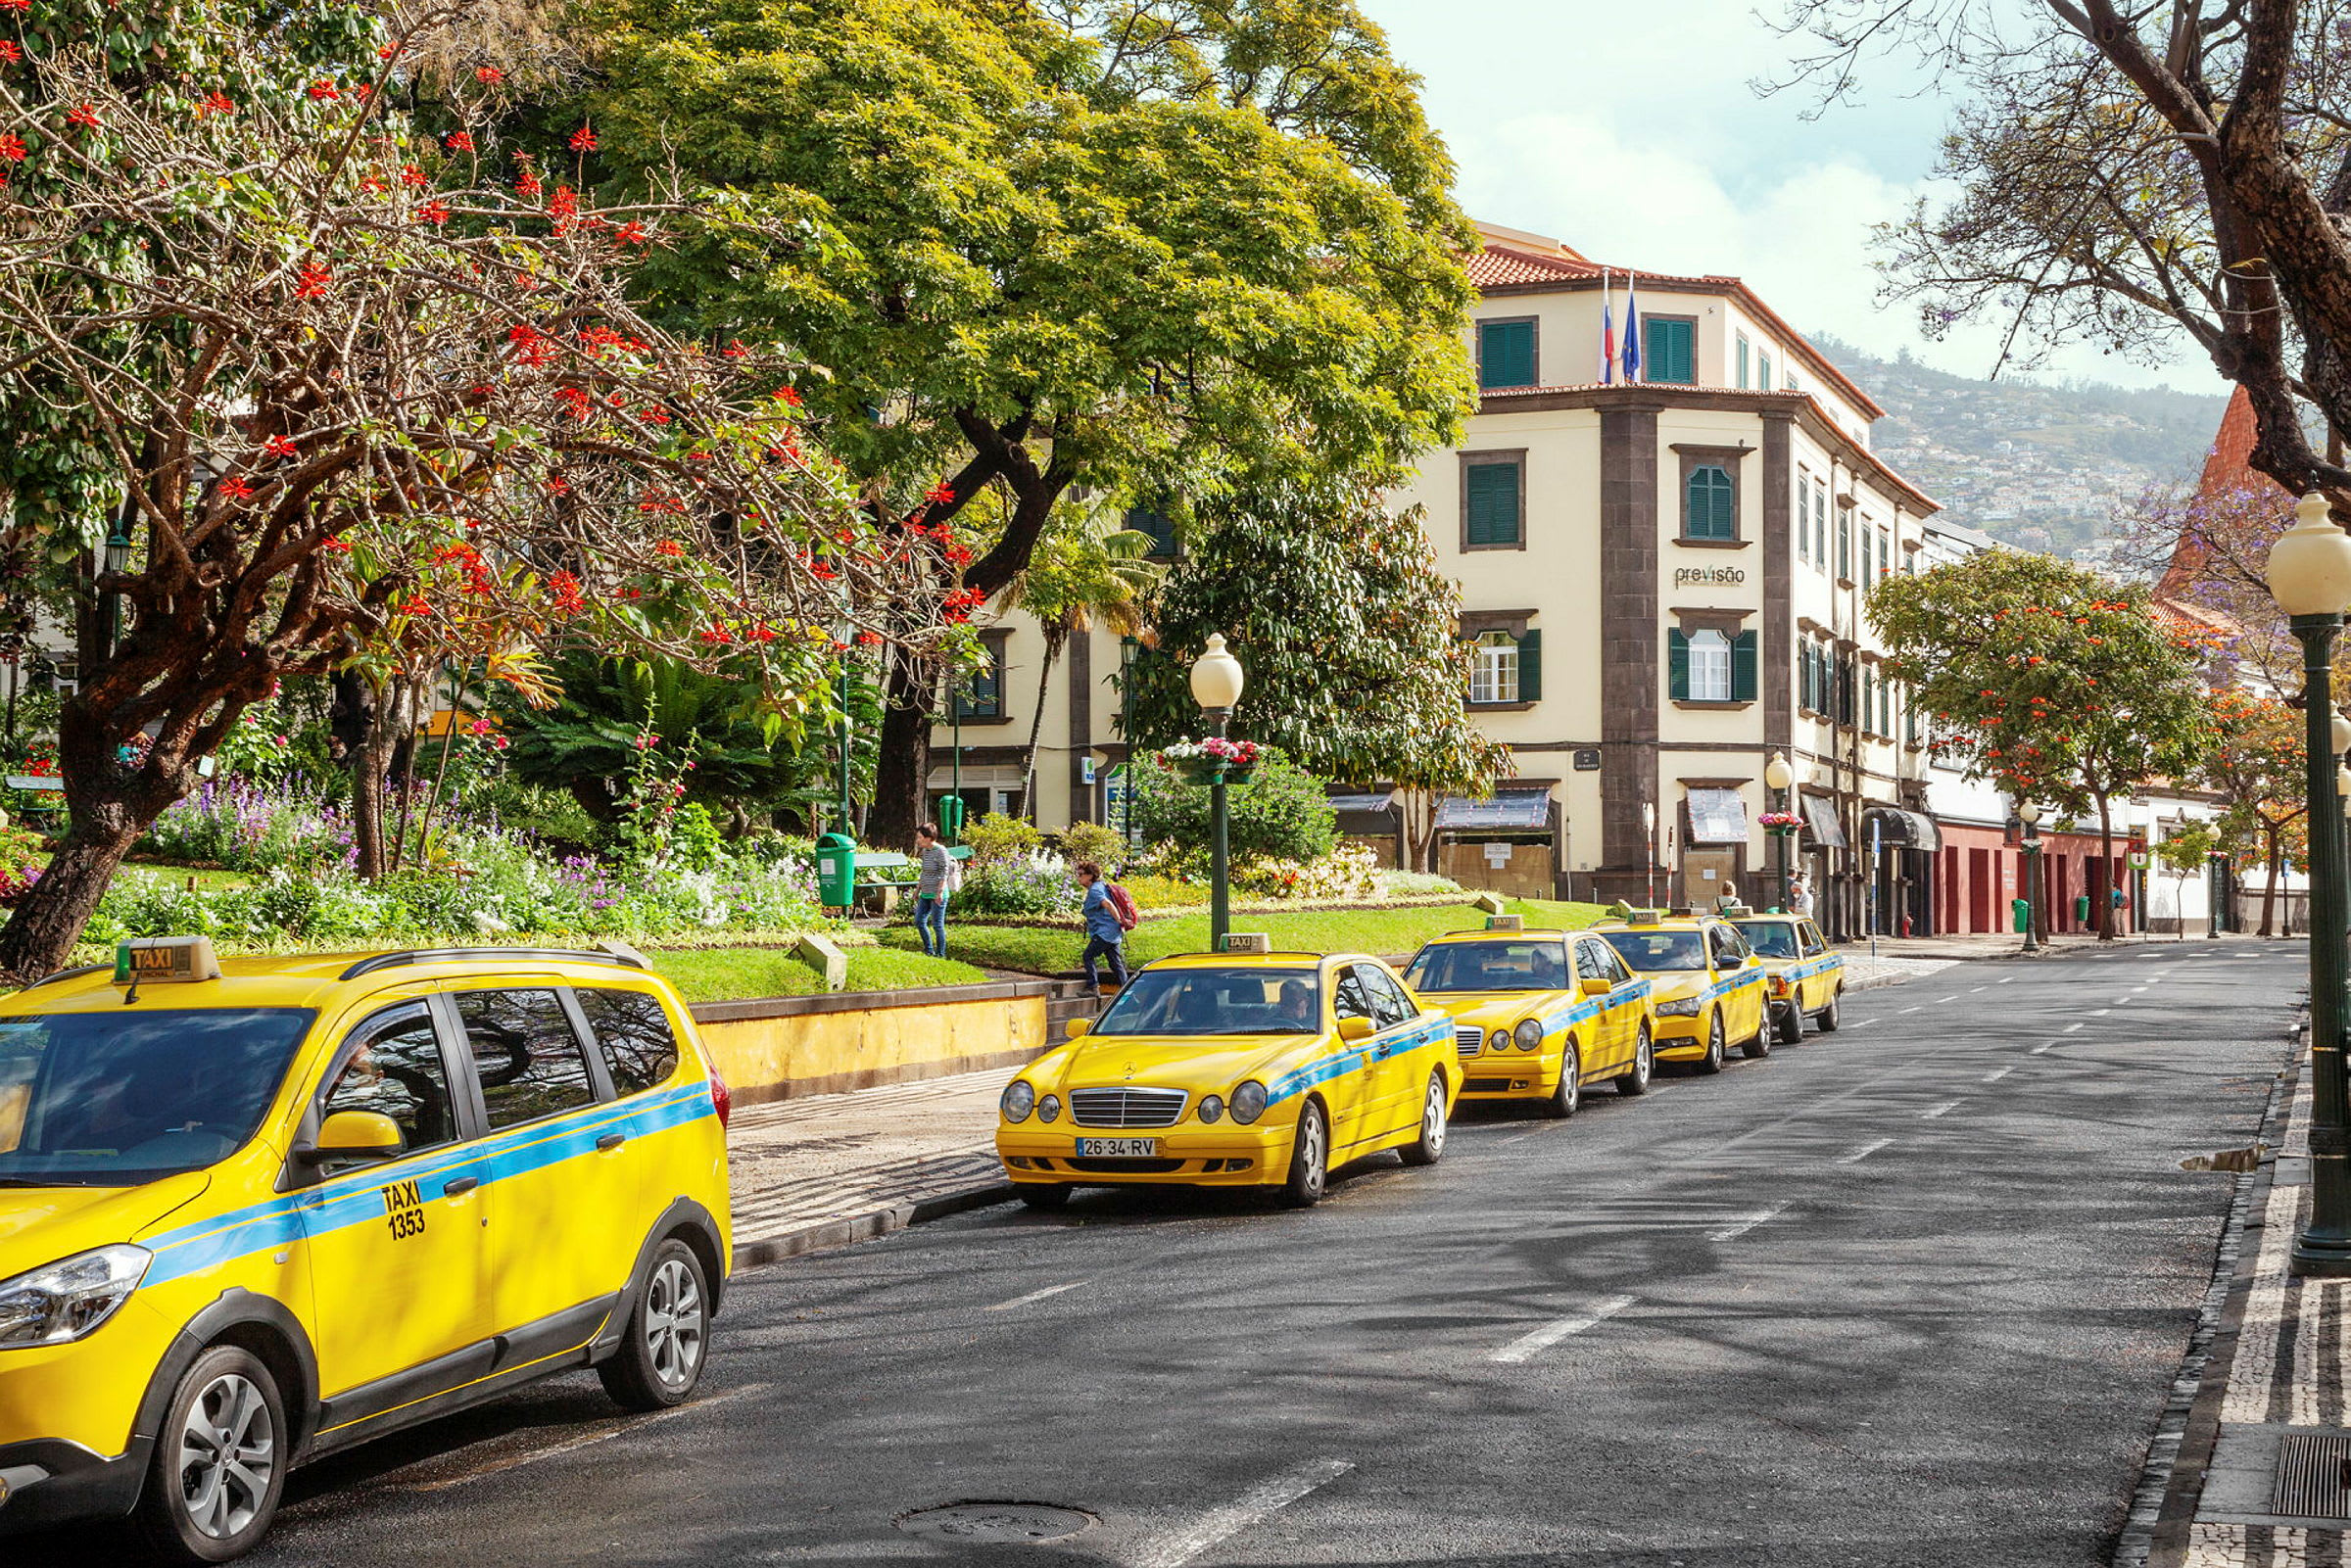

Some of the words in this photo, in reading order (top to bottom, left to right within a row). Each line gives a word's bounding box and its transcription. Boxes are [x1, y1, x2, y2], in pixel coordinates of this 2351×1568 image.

[1675, 564, 1745, 590] previsão
[1229, 936, 1251, 947] TAXI
[131, 948, 172, 969] TAXI
[381, 1179, 421, 1212] TAXI
[388, 1208, 425, 1241] 1353
